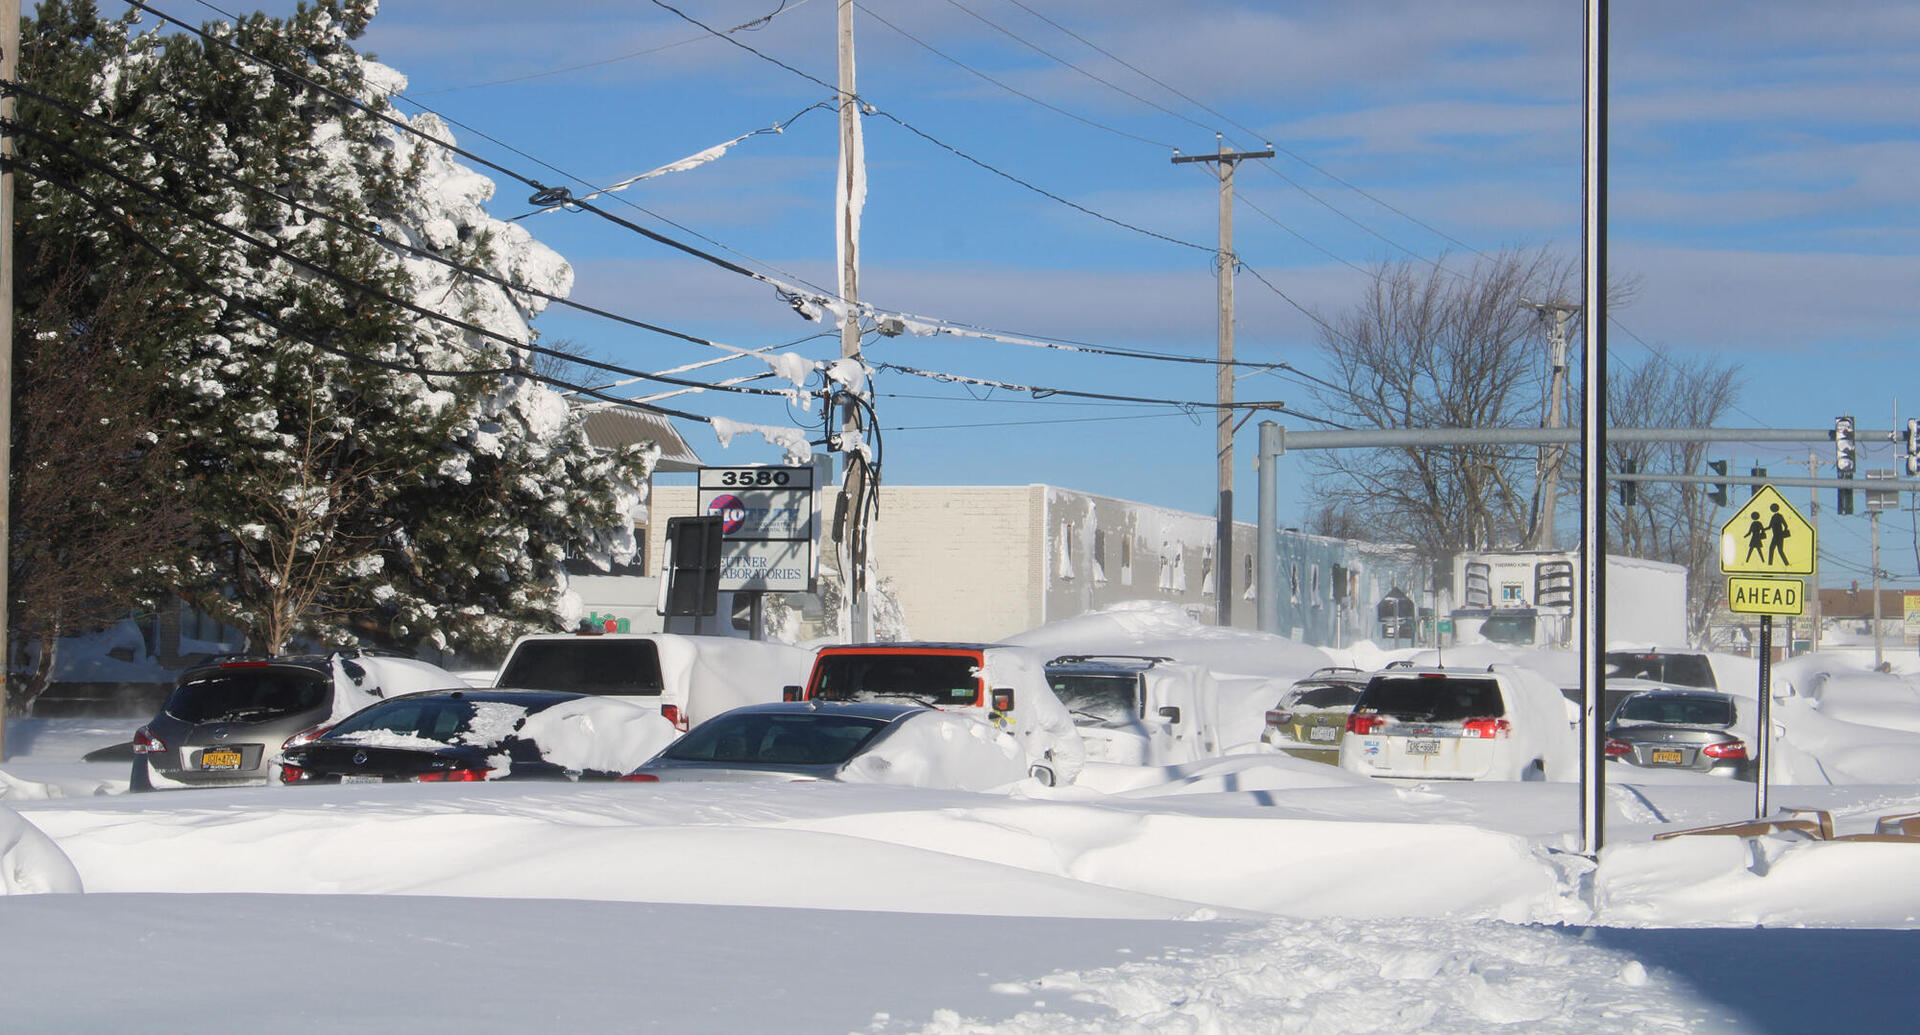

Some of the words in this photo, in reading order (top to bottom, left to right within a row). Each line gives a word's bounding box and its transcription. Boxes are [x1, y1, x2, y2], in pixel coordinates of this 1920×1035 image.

[722, 471, 790, 486] 3580
[720, 556, 767, 567] EUTNER
[721, 568, 801, 580] ABORATORIES
[1735, 587, 1796, 606] AHEAD
